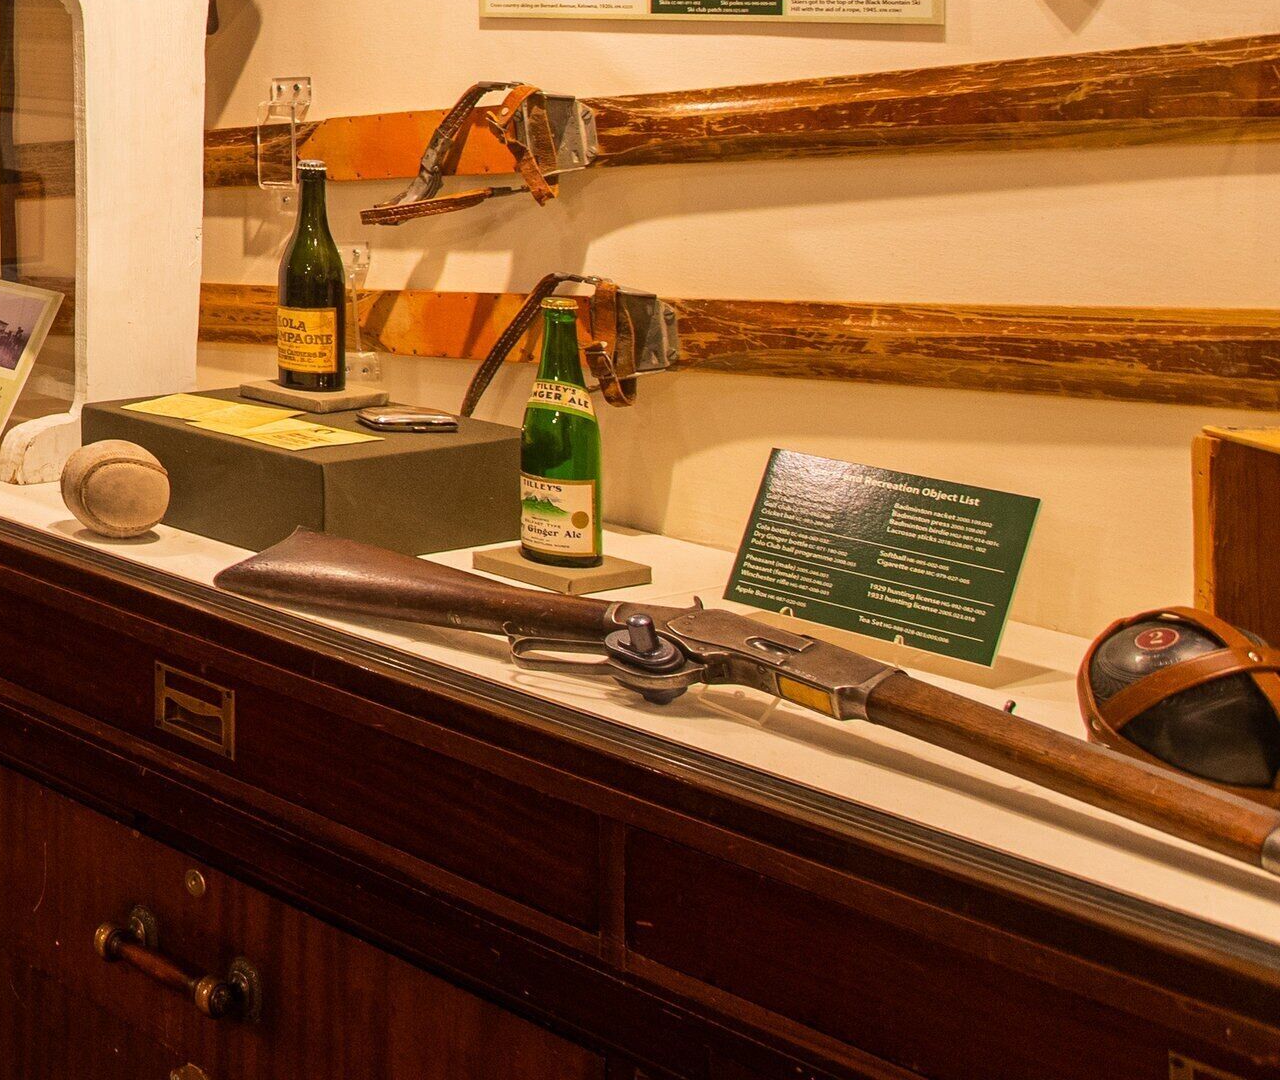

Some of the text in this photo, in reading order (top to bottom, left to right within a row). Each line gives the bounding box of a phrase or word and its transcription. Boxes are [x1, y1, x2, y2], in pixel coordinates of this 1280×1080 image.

[282, 317, 307, 332] OLA
[536, 382, 577, 395] TILLEY'S
[533, 391, 589, 409] NGER ALE
[864, 475, 920, 495] Recreation
[922, 487, 958, 502] Object
[960, 494, 980, 507] List
[527, 524, 582, 539] Ginger Ale
[870, 583, 887, 592] 1929
[887, 586, 916, 600] hunting
[1149, 631, 1163, 644] 2
